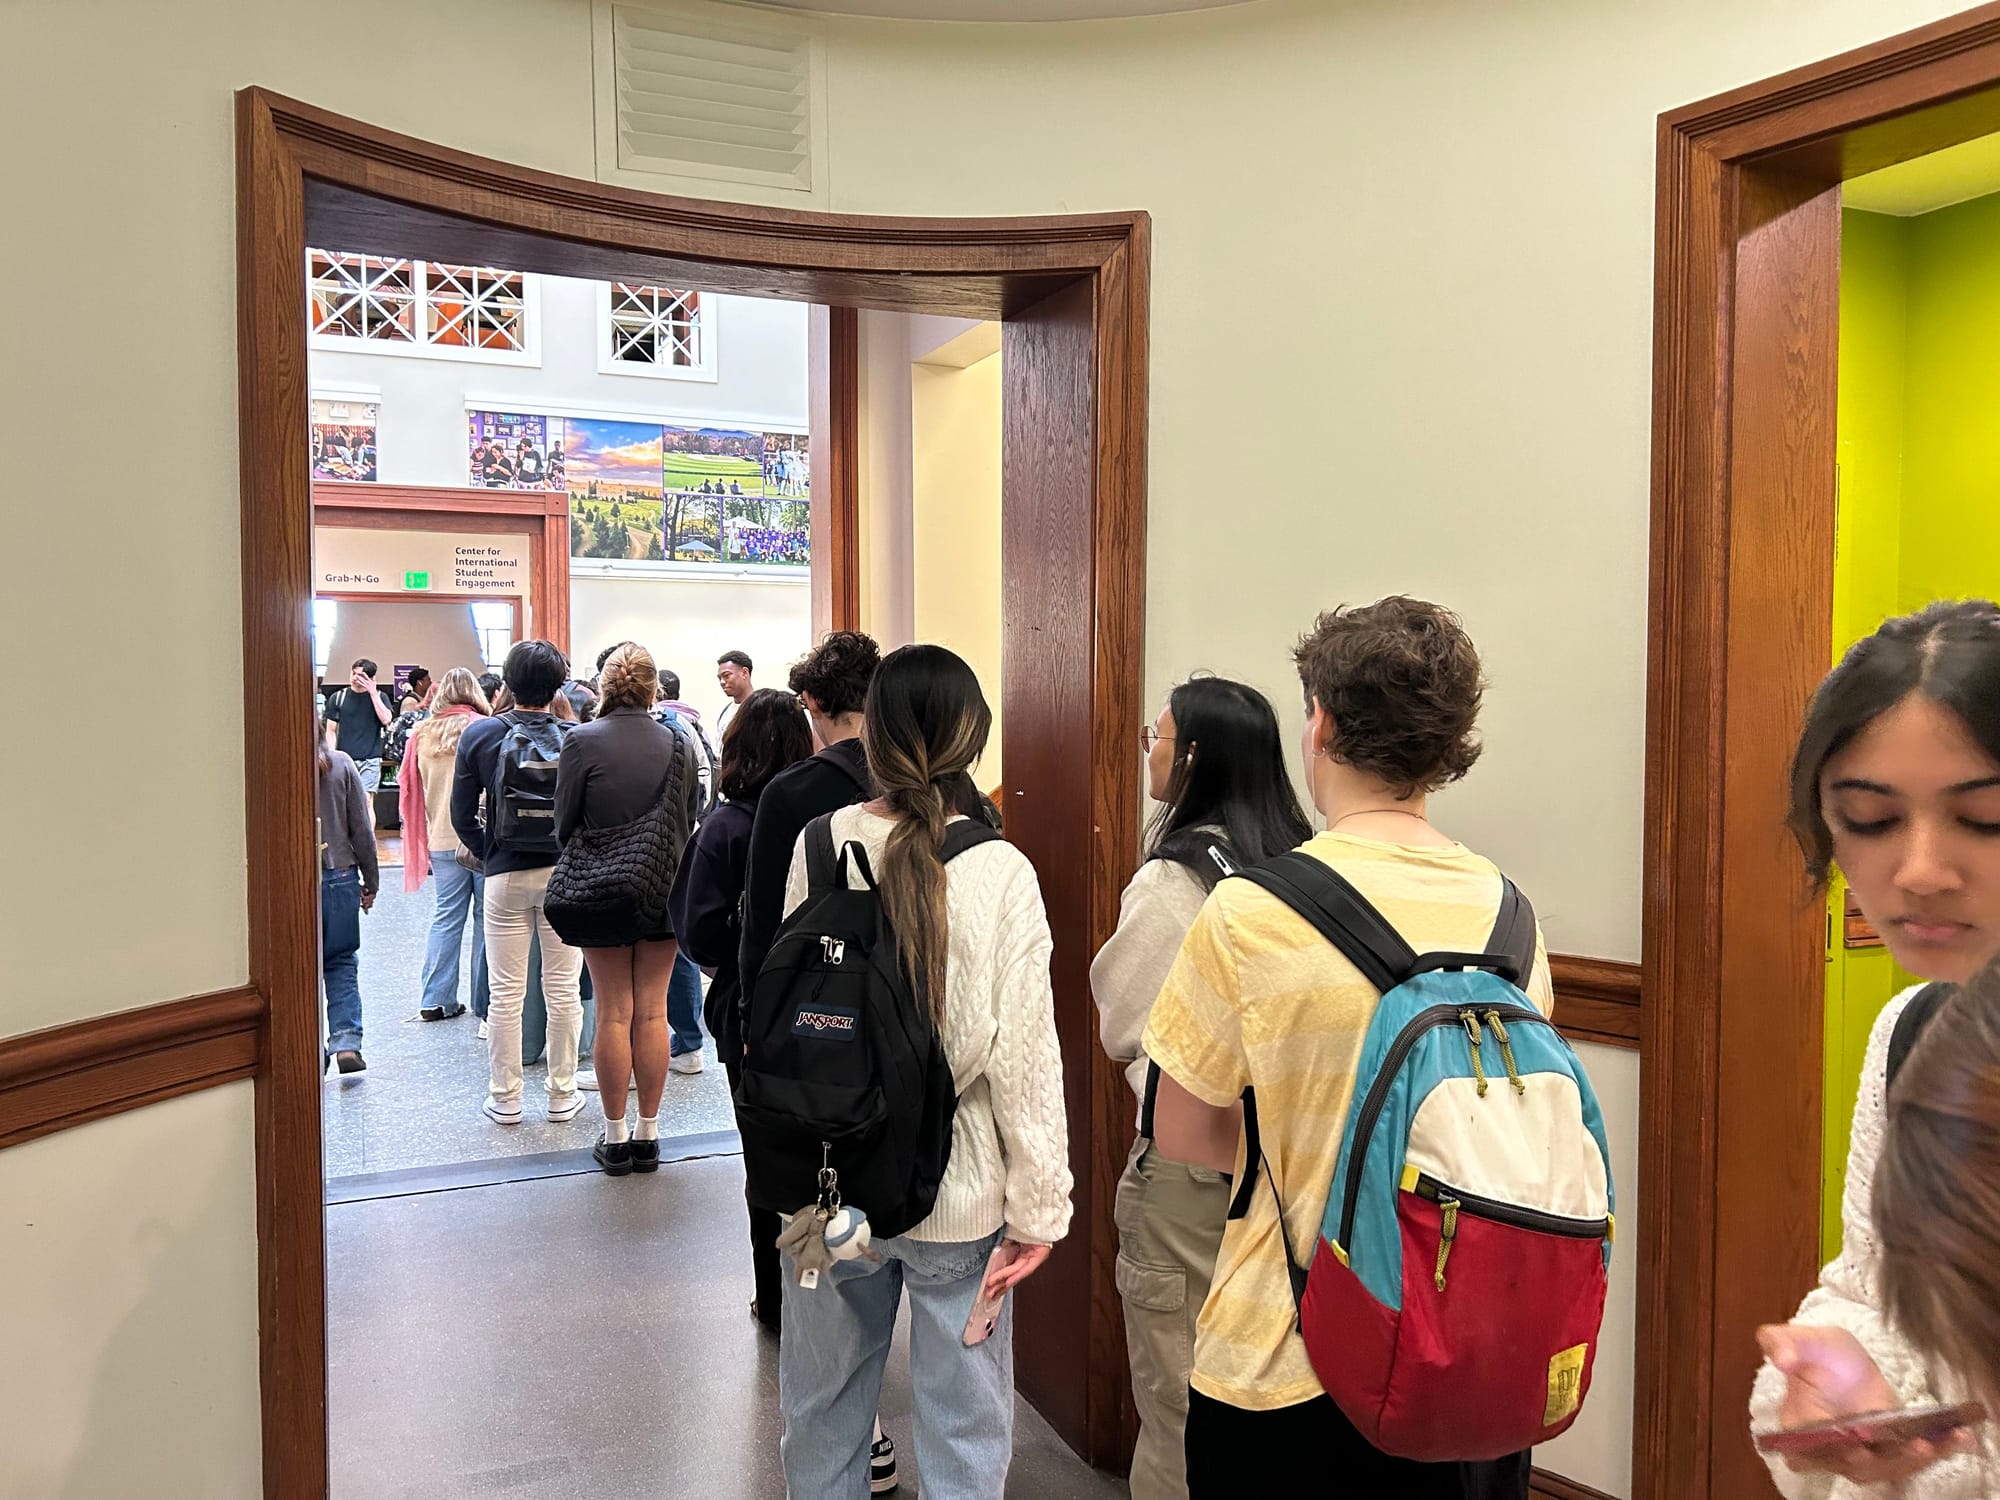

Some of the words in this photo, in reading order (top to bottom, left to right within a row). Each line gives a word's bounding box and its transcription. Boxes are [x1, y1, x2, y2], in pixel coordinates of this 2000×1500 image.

[455, 547, 485, 555] Center
[487, 547, 501, 555] for
[455, 558, 517, 567] International
[455, 568, 493, 577] Student
[325, 573, 380, 583] Grab-N-Go
[455, 578, 515, 589] Engagement
[796, 1011, 854, 1030] JANSPORT
